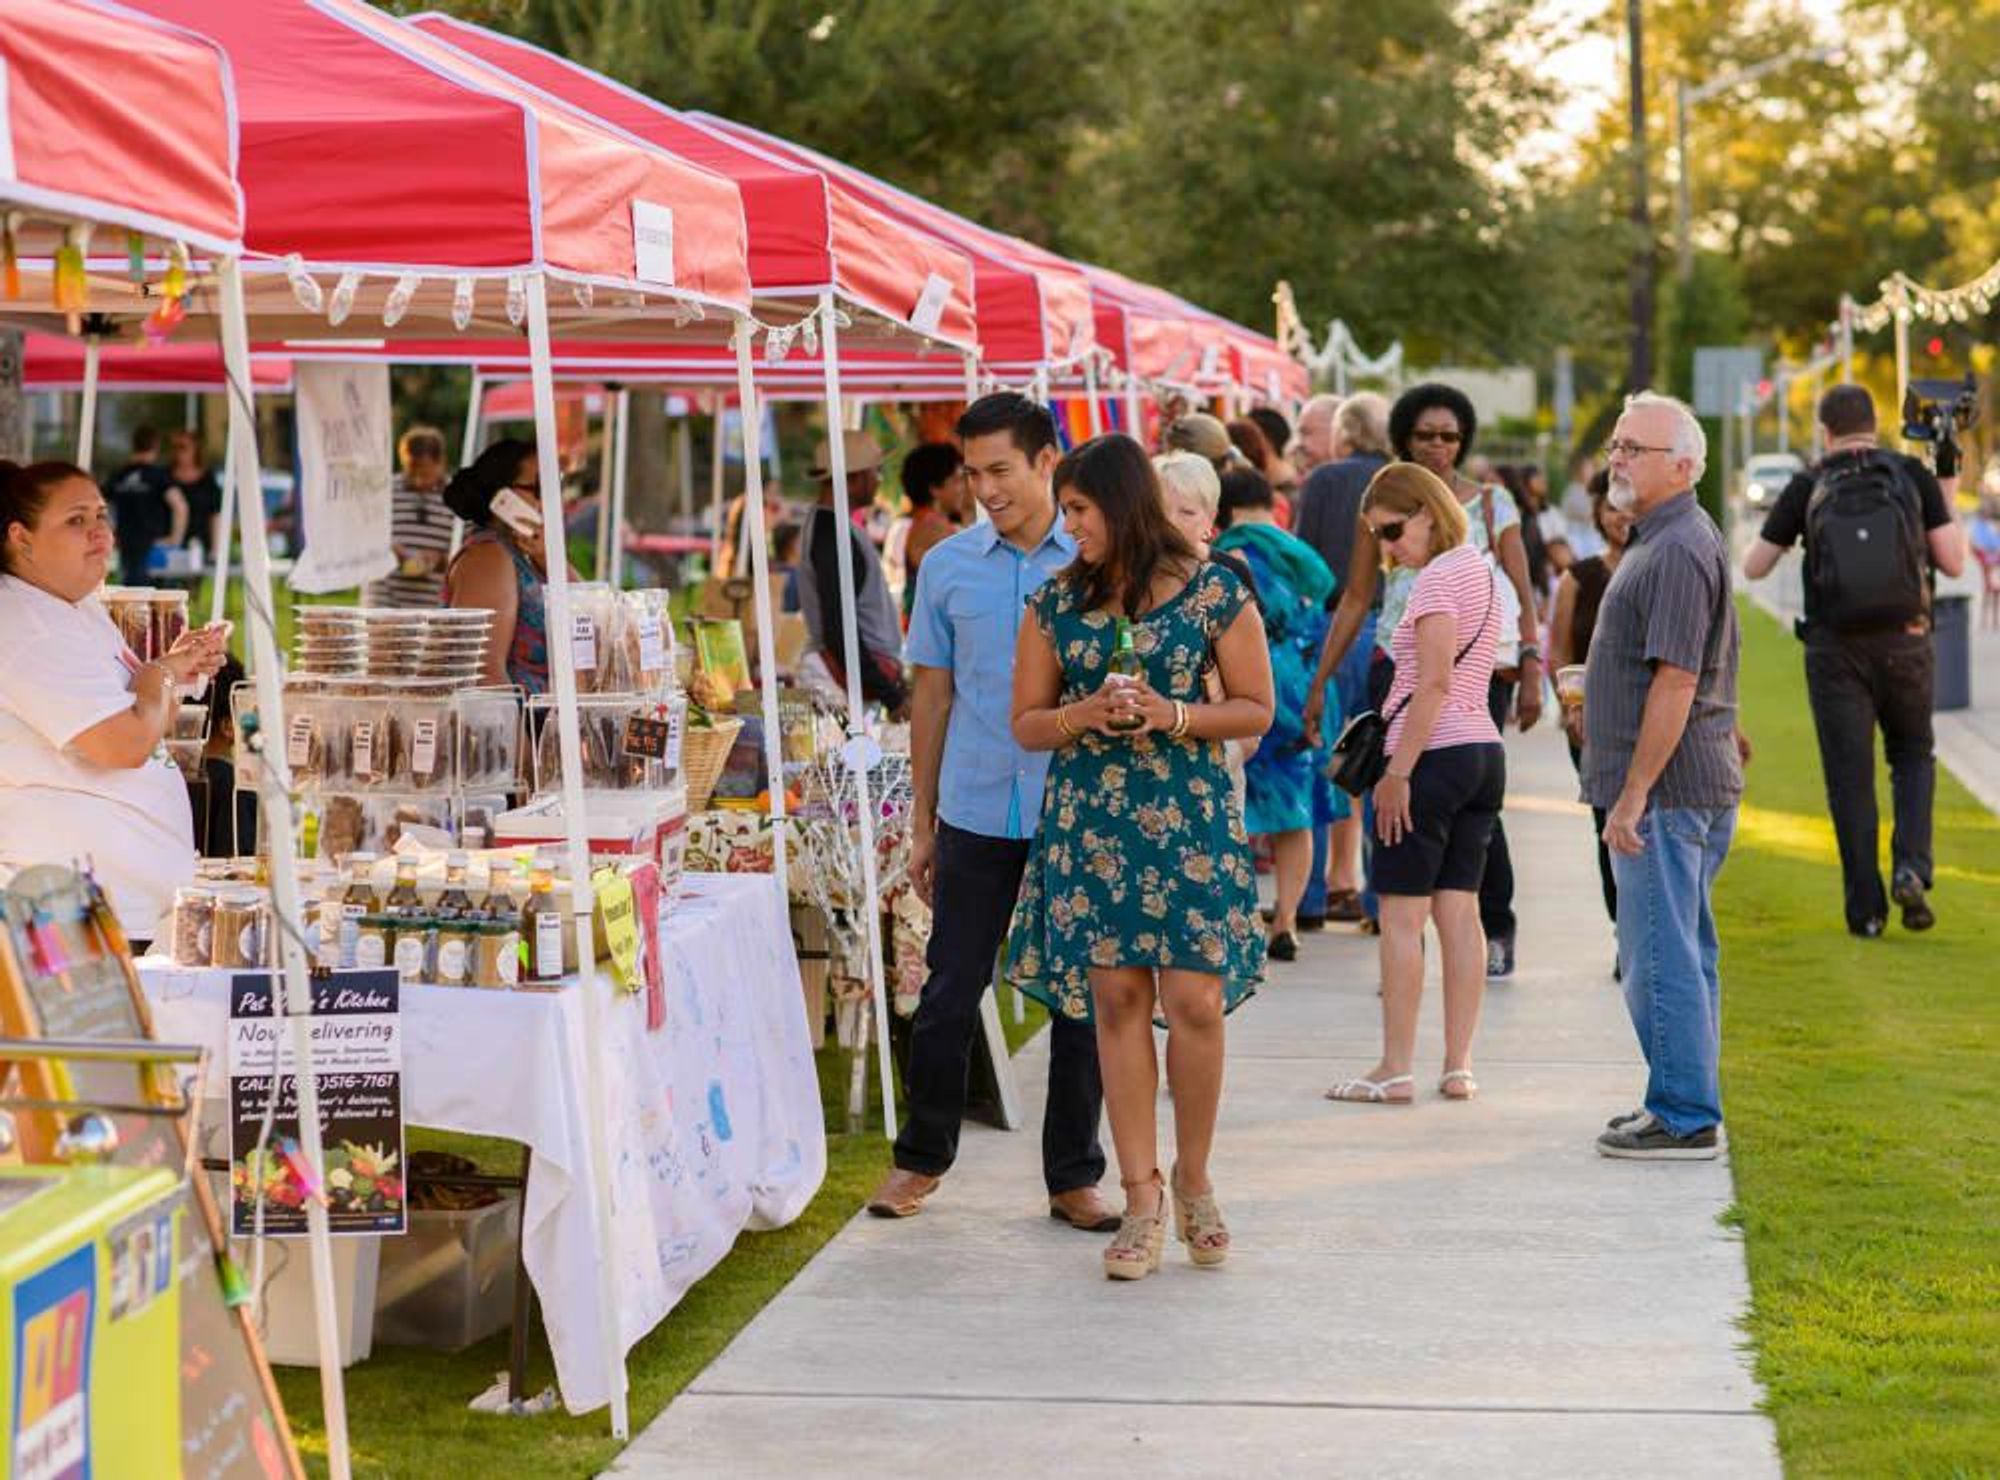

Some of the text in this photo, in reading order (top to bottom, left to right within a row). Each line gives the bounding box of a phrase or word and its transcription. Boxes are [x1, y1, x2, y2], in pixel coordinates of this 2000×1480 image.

[238, 992, 267, 1013] Pat
[333, 988, 390, 1009] Kitchen
[310, 1021, 393, 1042] elivering
